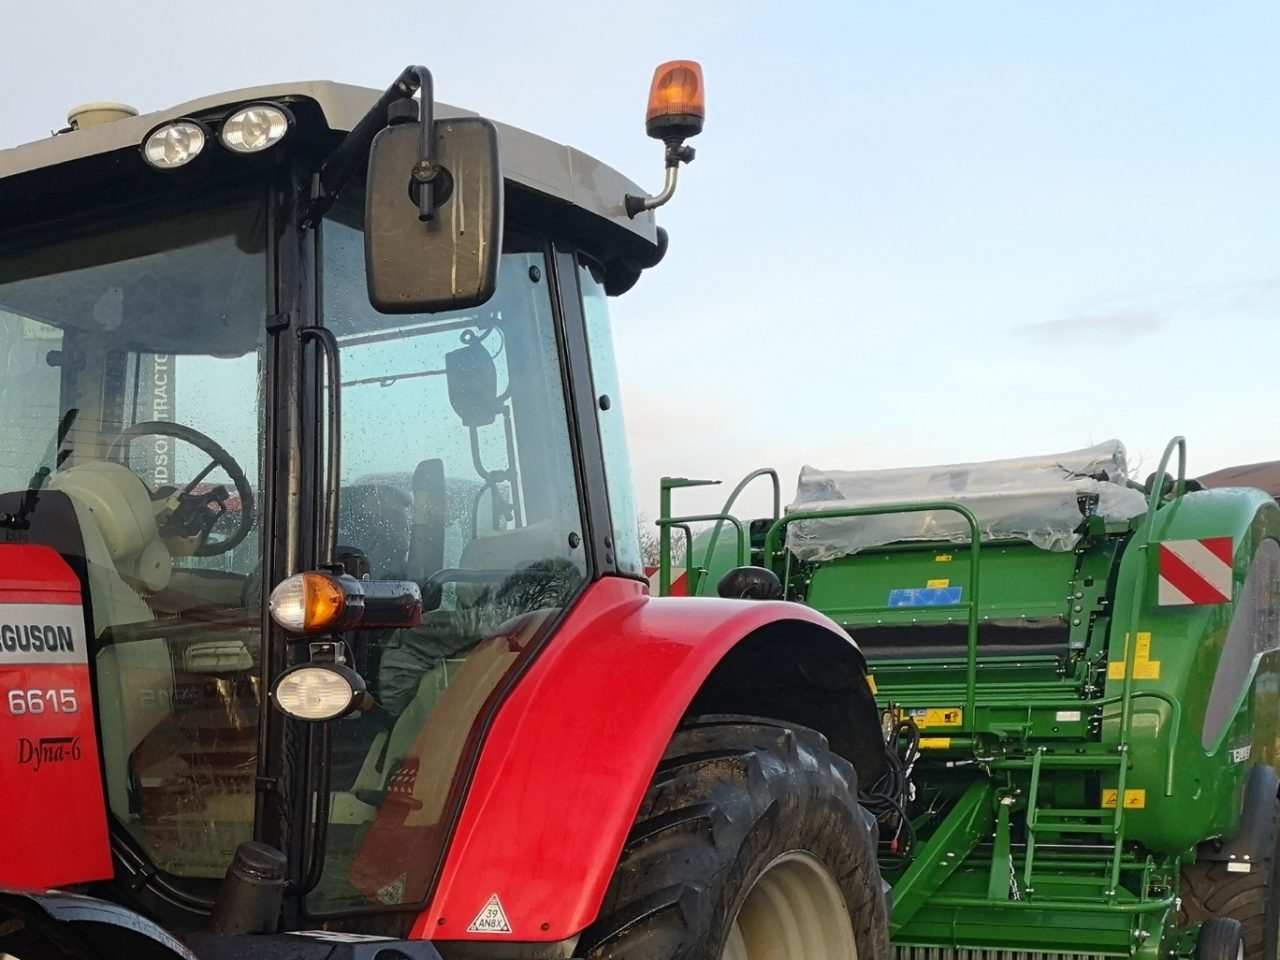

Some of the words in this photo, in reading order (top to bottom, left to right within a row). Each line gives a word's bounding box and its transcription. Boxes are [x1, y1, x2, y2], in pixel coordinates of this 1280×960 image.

[8, 688, 79, 715] 6615
[18, 737, 81, 771] Dyna-6
[478, 918, 503, 928] AN8X
[485, 909, 498, 919] 39
